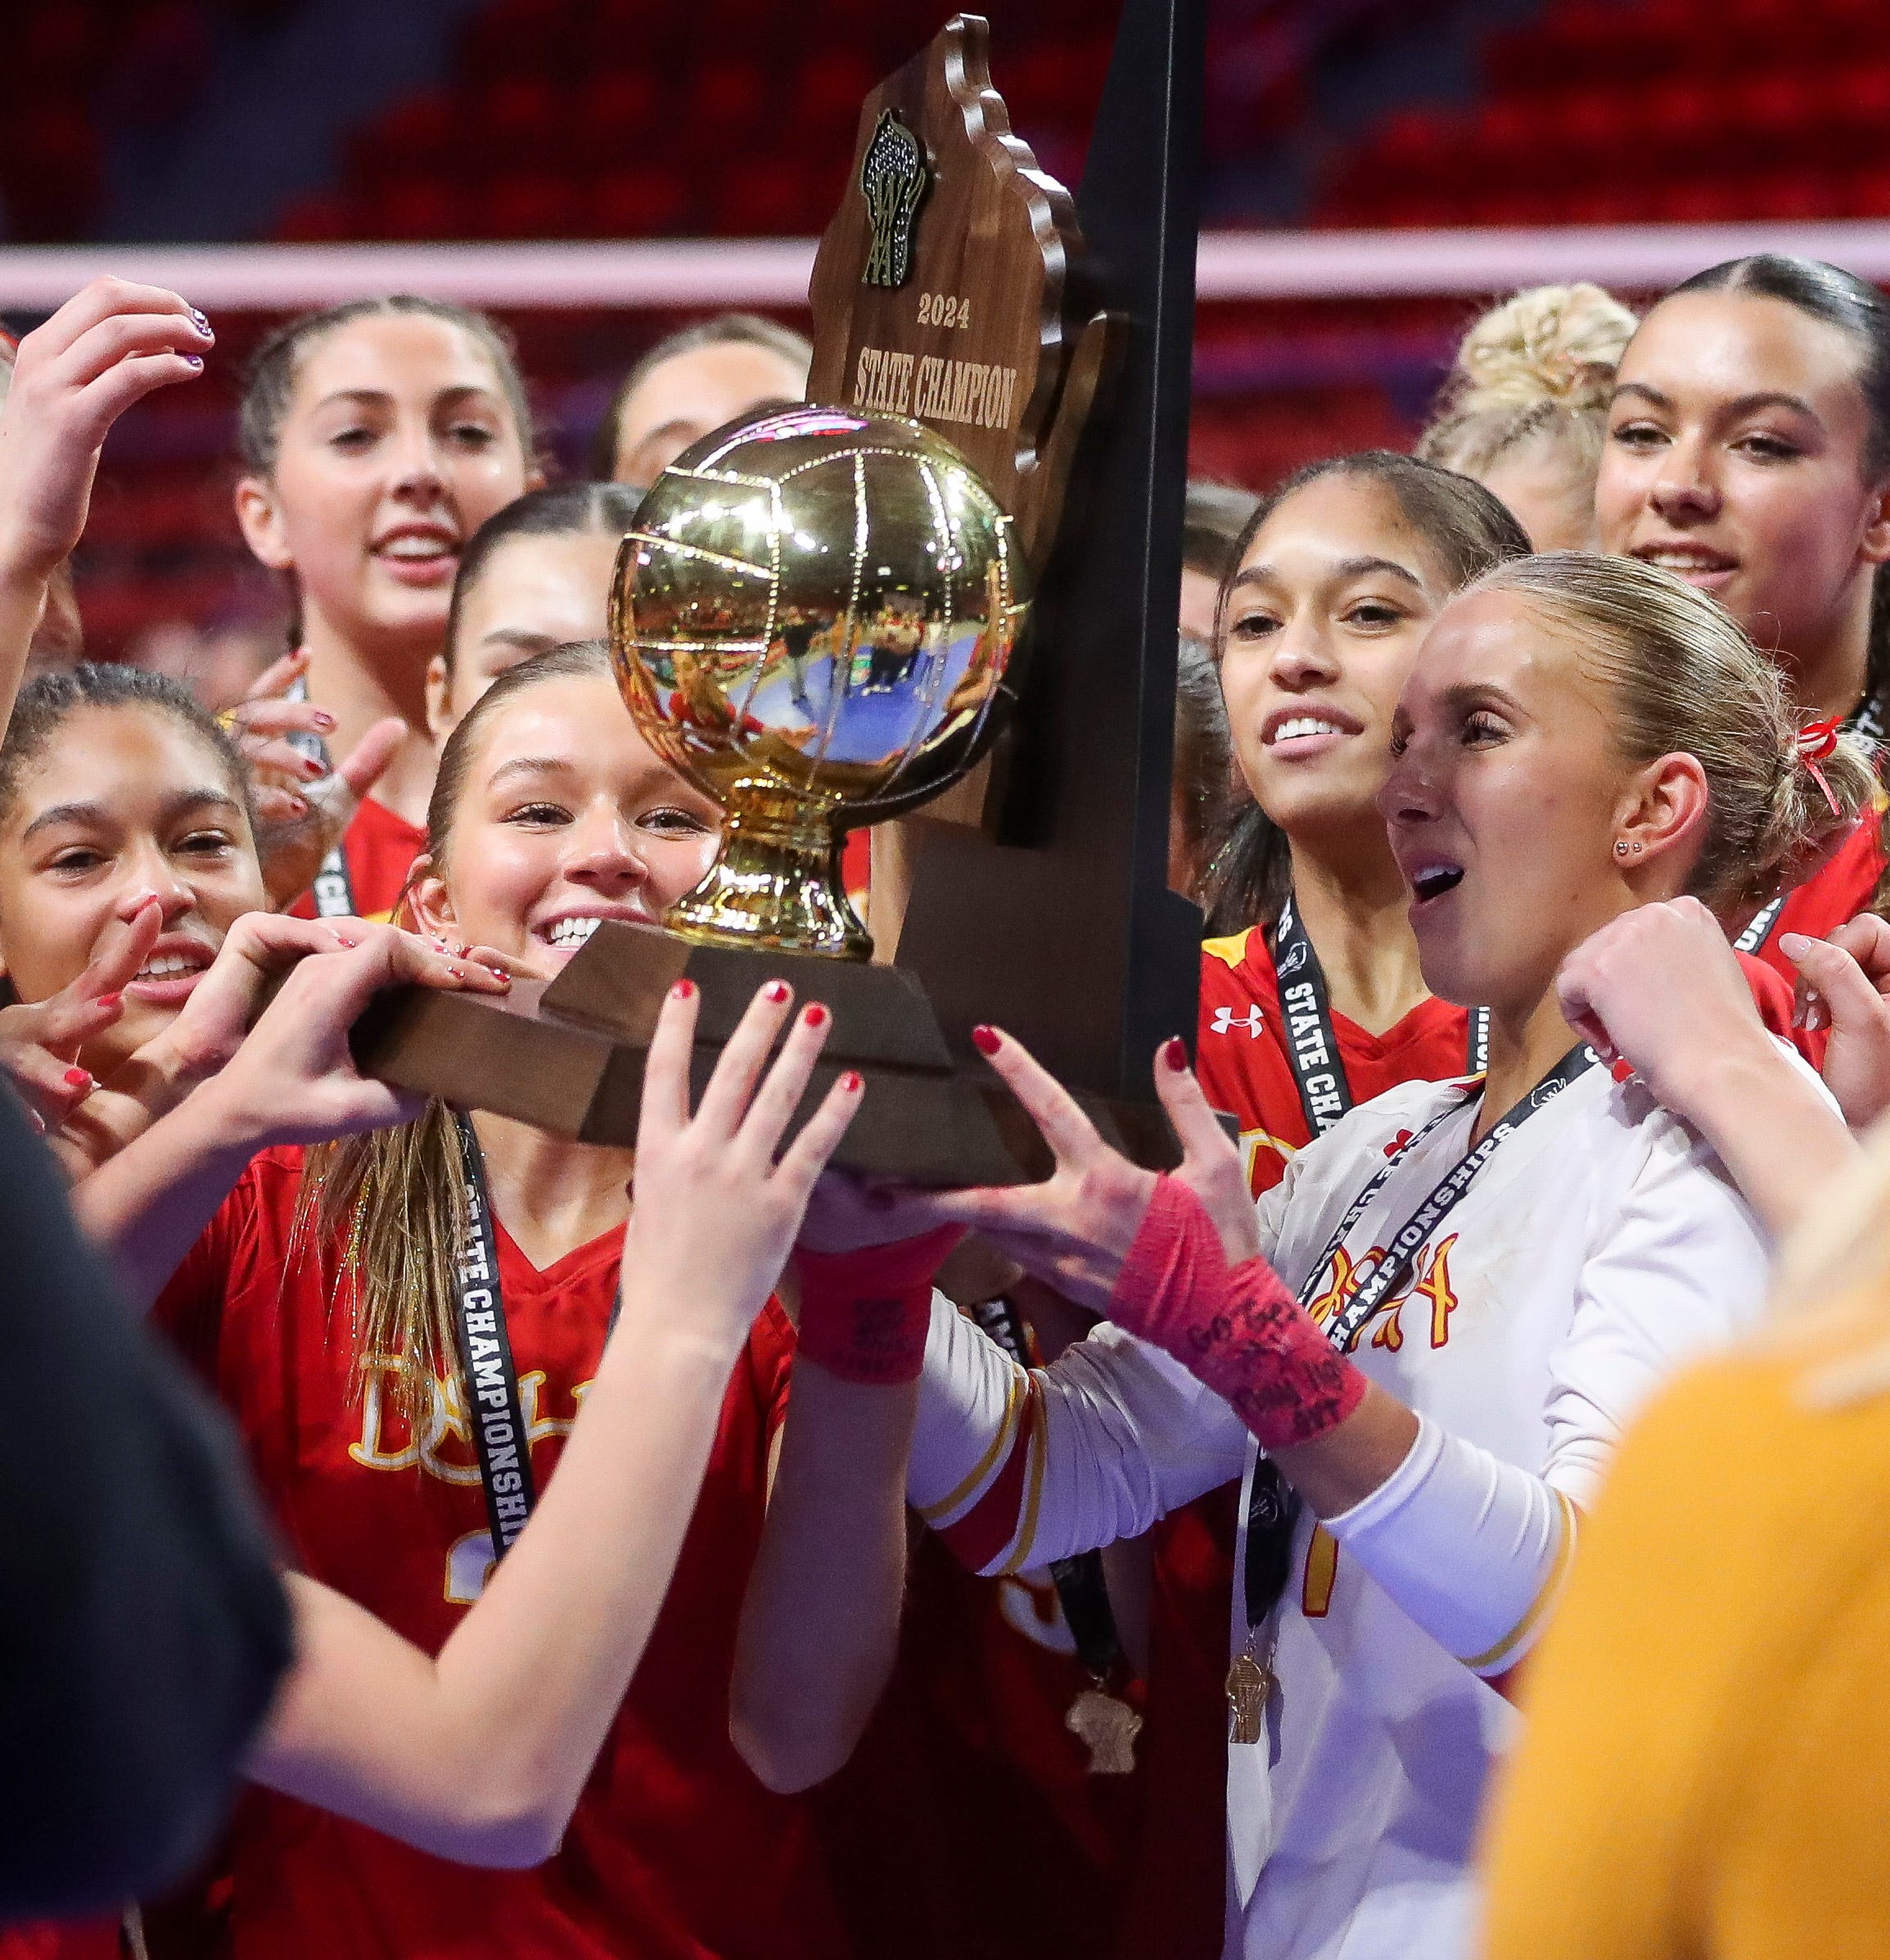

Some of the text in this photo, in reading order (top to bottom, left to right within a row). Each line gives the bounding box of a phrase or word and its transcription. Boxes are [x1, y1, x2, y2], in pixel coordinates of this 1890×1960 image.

[917, 292, 971, 329] 2024
[853, 345, 1017, 430] STATE CHAMPION
[1284, 982, 1329, 1072] STATE
[1328, 1122, 1516, 1352] HAMPIONSHIPS
[462, 1288, 529, 1546] CHAMPIONSHI
